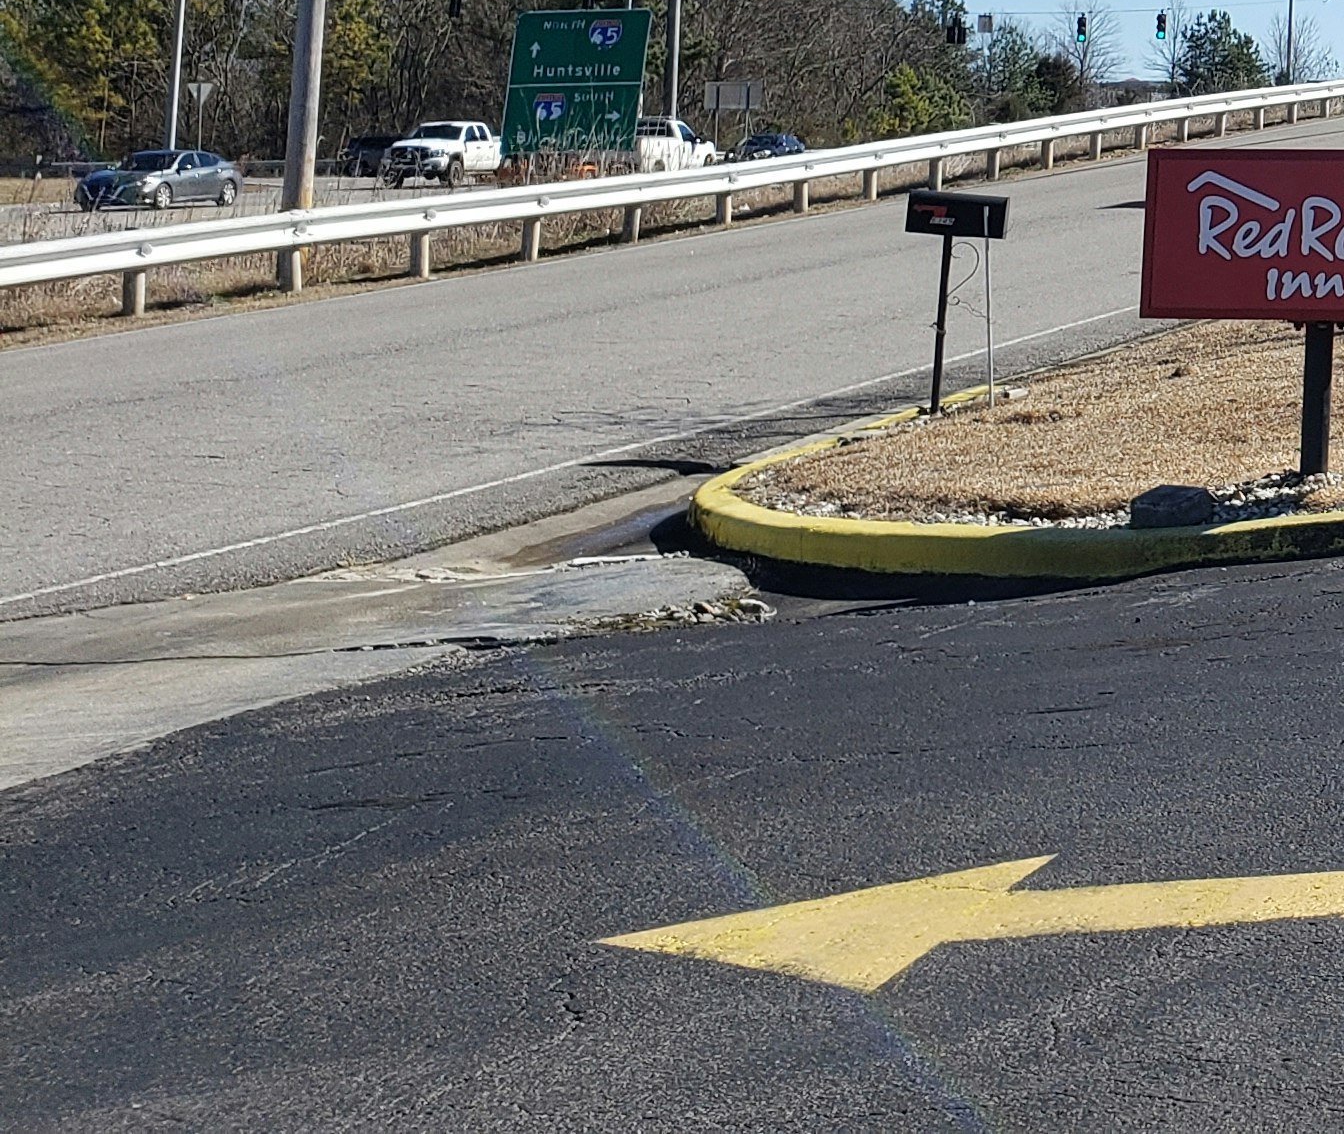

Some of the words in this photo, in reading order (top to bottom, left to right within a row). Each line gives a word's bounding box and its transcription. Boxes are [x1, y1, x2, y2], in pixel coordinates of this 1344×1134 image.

[543, 18, 586, 31] NORTH
[590, 27, 619, 45] 65
[533, 63, 621, 78] Huntsville
[536, 102, 563, 121] 65
[573, 90, 615, 102] SOUTH
[1198, 195, 1296, 261] Red
